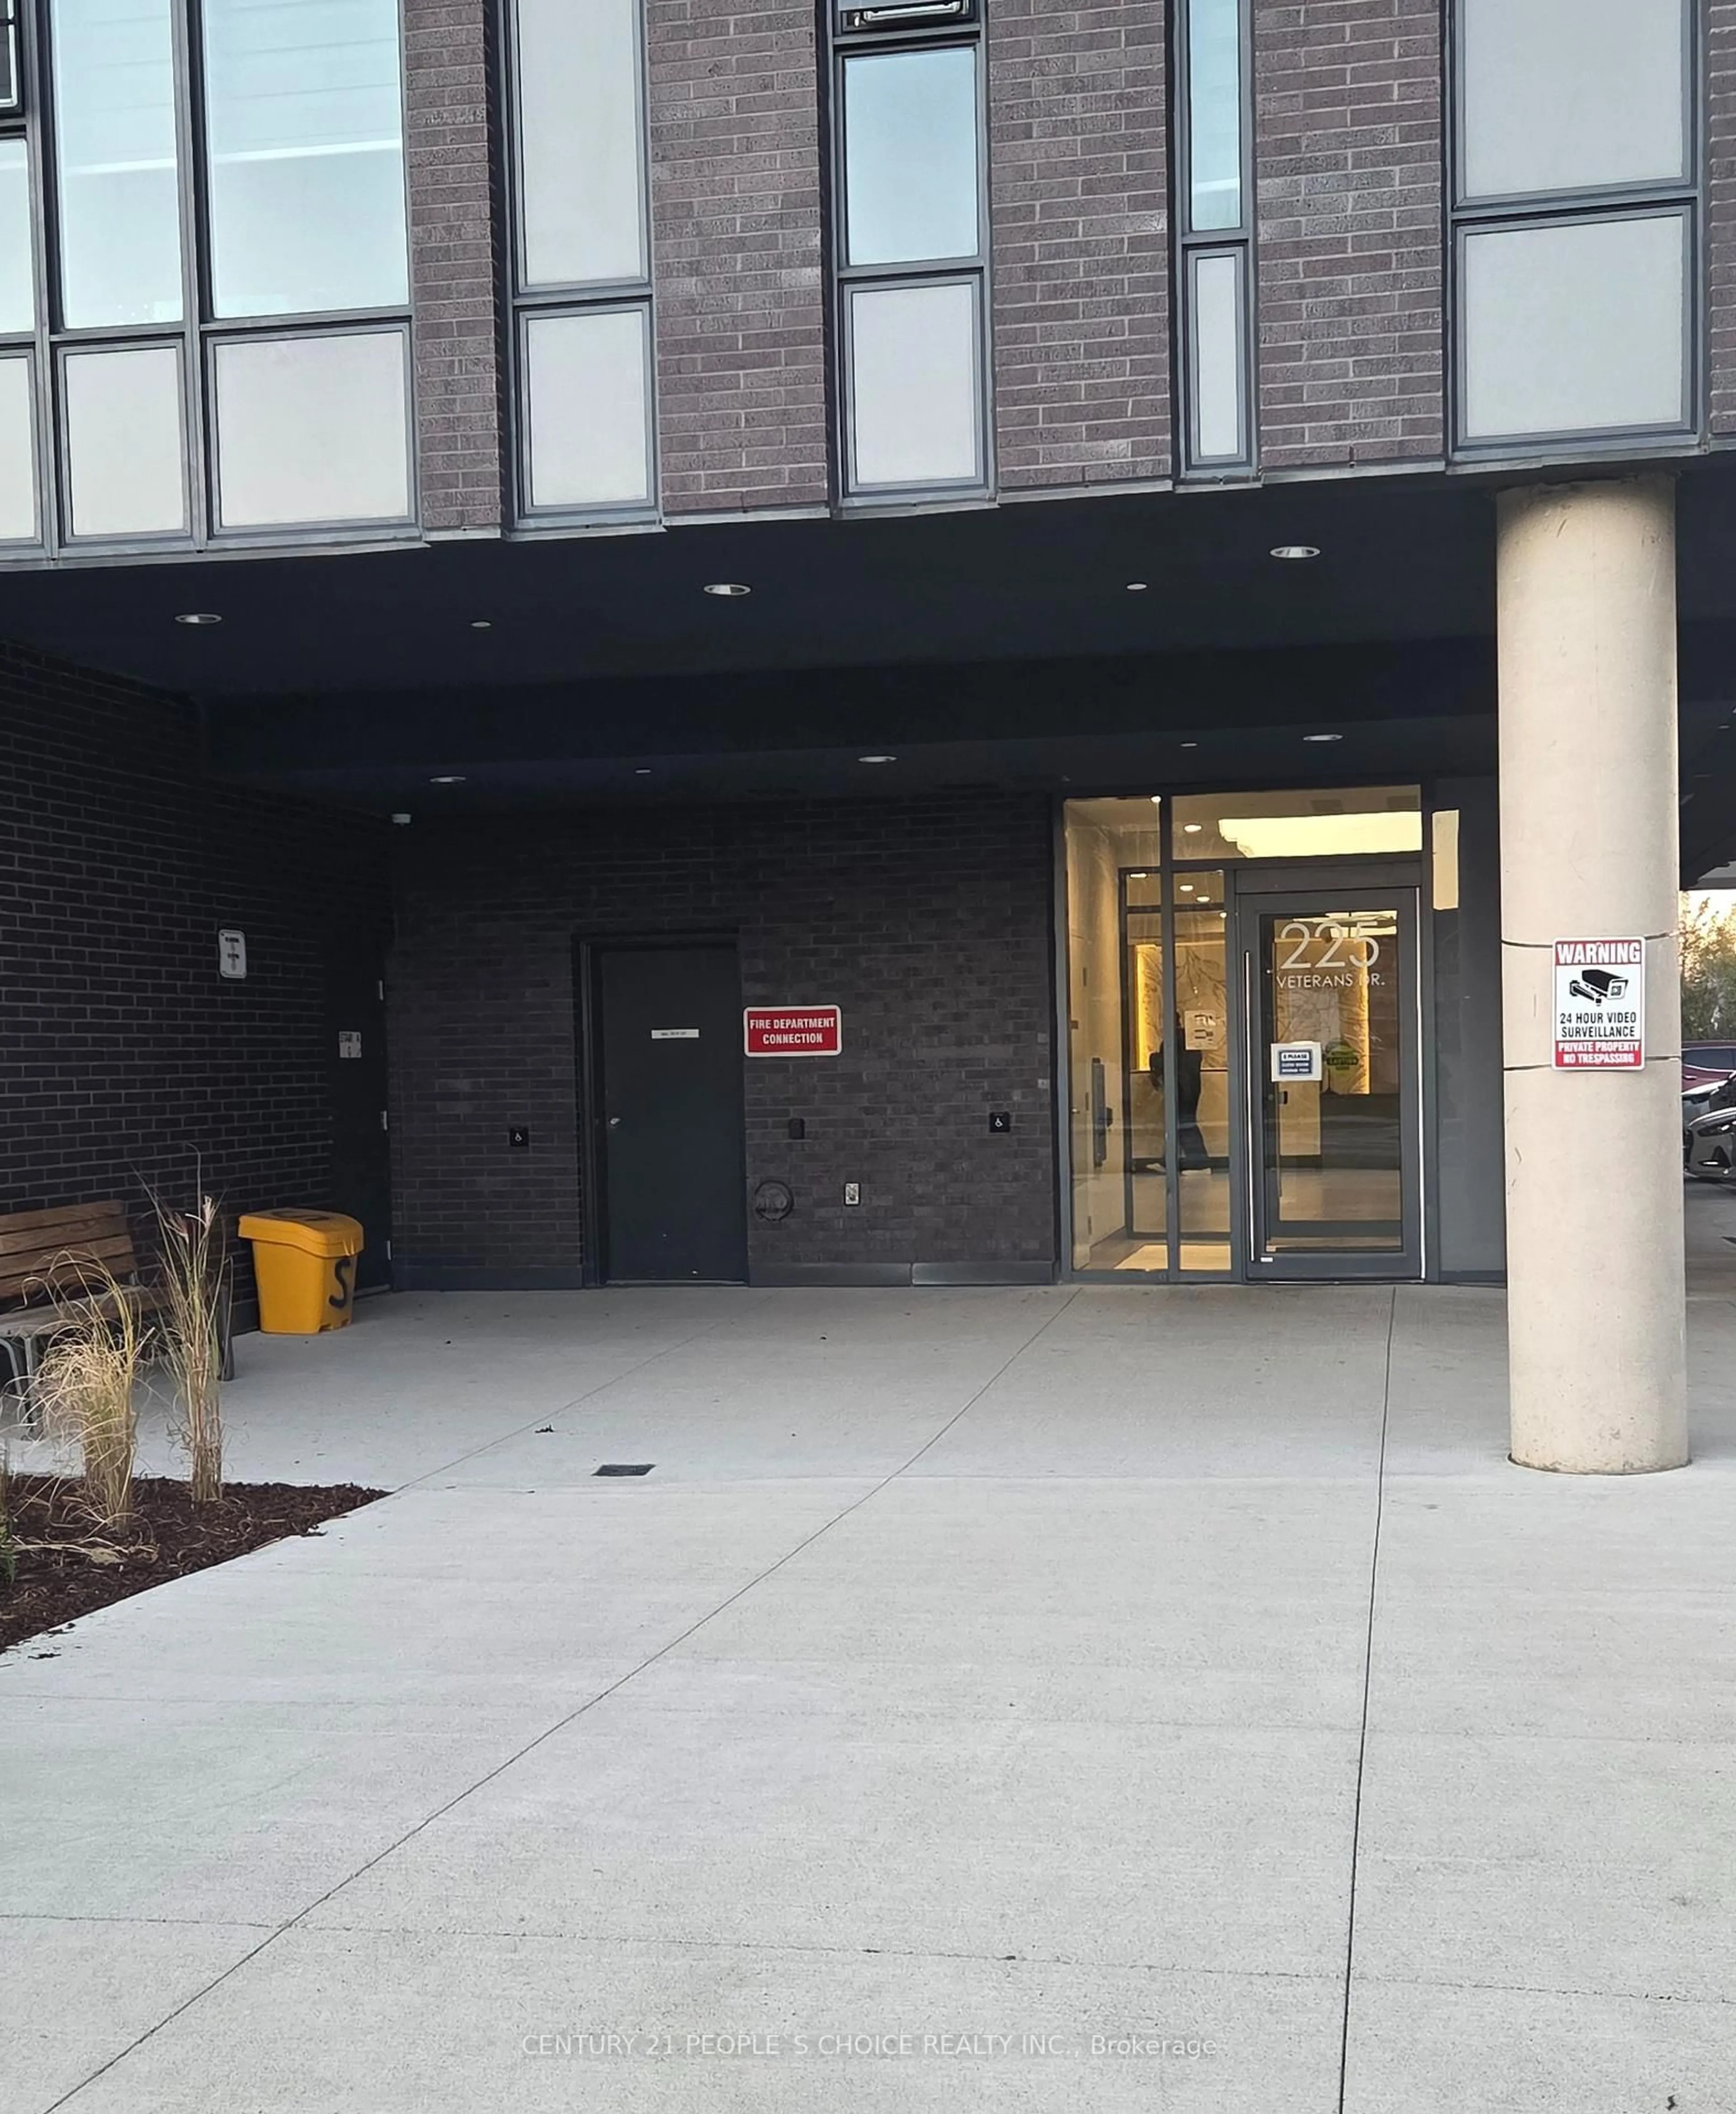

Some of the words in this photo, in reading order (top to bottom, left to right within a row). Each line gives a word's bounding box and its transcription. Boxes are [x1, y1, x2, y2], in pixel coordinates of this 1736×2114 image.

[1280, 921, 1380, 969] 225
[1557, 941, 1640, 964] WARNING
[1276, 974, 1353, 989] VETERANS
[750, 1019, 772, 1030] FIRE
[774, 1017, 835, 1029] DEPARTMENT
[1560, 1012, 1572, 1024] 24
[1576, 1012, 1604, 1023] HOUR
[1607, 1012, 1637, 1023] VIDEO
[763, 1032, 823, 1044] CONNECTION
[1561, 1026, 1635, 1038] SURVEILLANCE
[1558, 1042, 1594, 1052] PRIVATE
[1595, 1041, 1640, 1052] PROPERTY
[1563, 1054, 1576, 1064] NO
[1578, 1053, 1635, 1064] TRESPASSING
[328, 1258, 351, 1309] S
